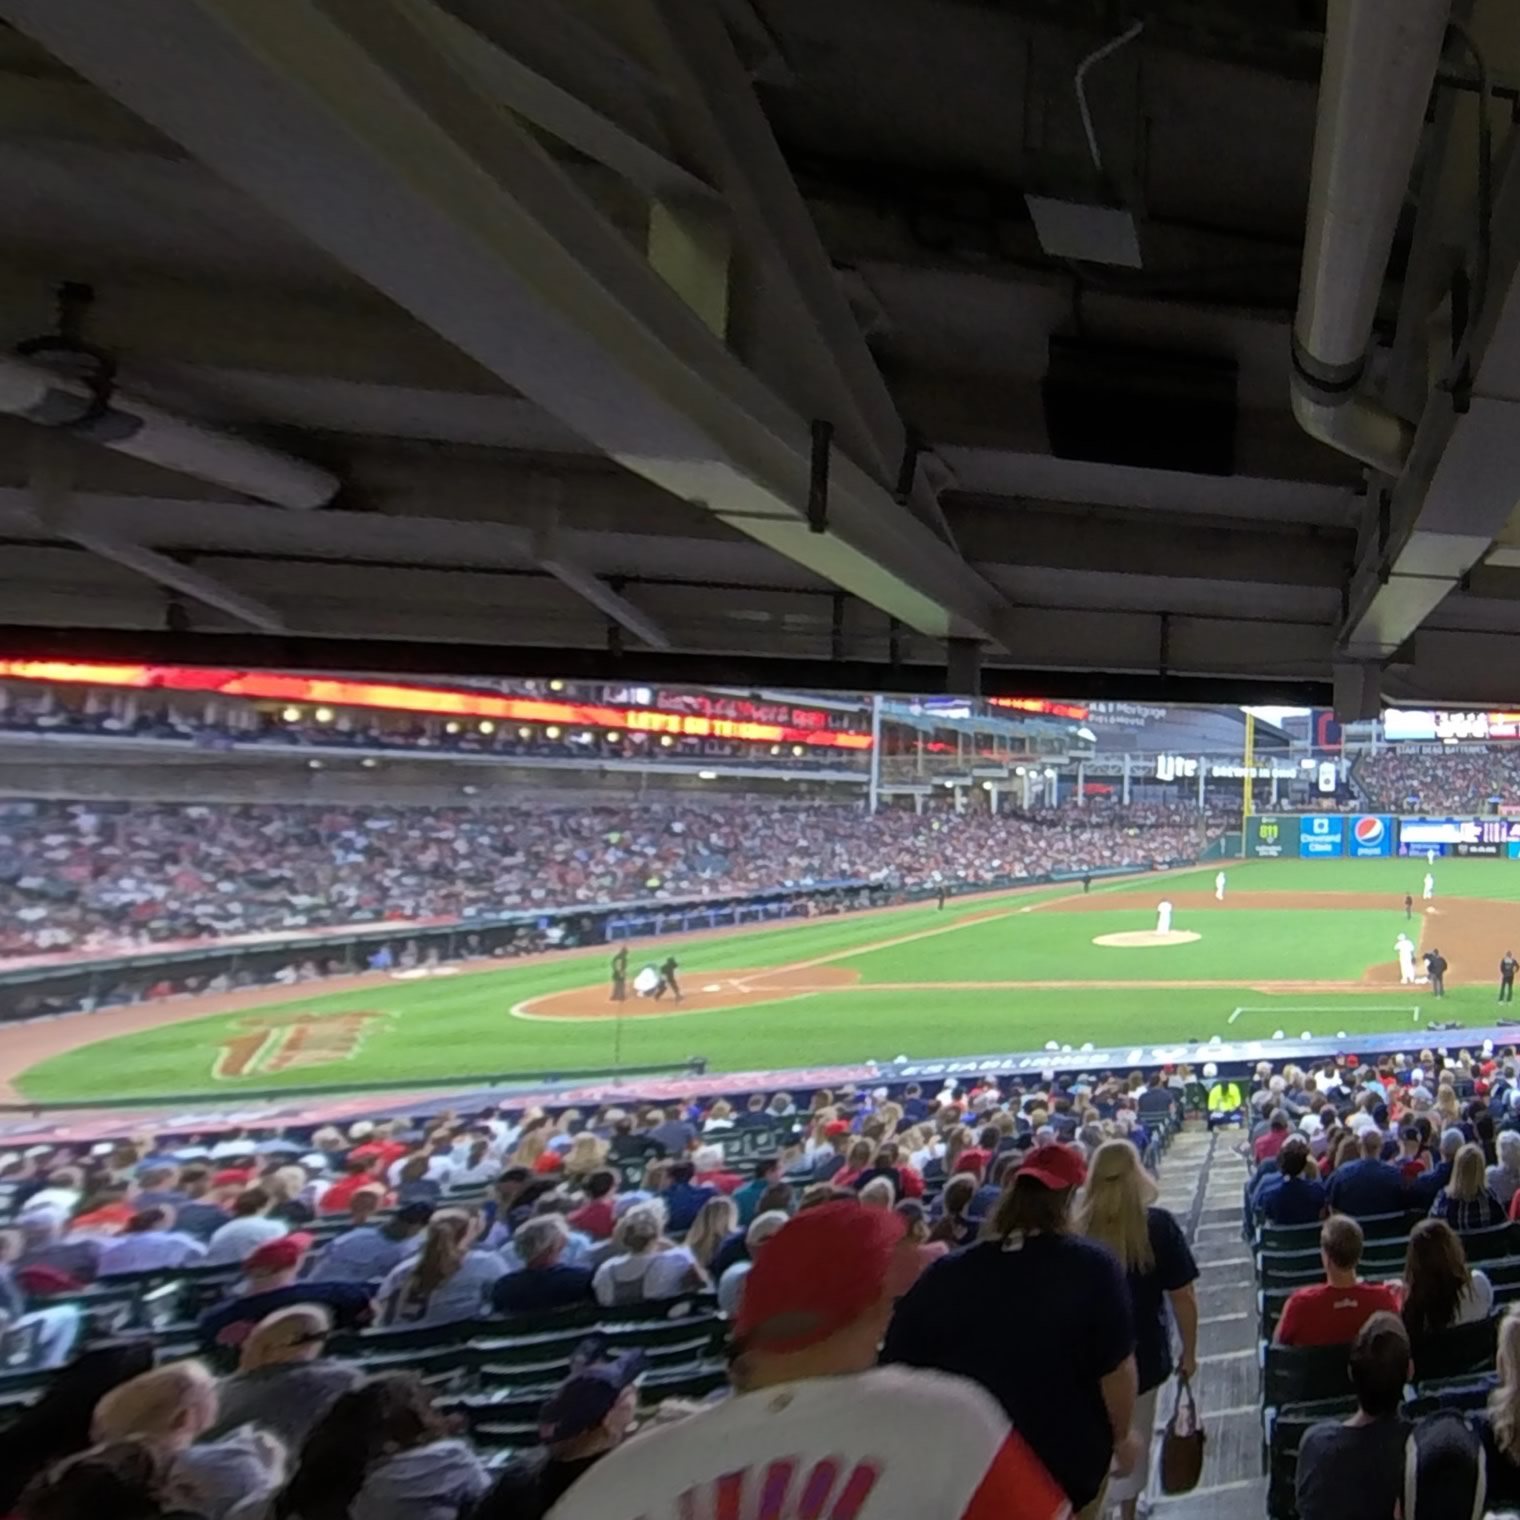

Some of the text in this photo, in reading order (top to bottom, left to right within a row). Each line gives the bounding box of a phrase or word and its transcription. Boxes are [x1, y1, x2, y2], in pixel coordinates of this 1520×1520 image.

[1156, 755, 1198, 782] Lite
[1300, 833, 1341, 843] Cleveland
[1308, 843, 1332, 852] Clinic
[900, 1052, 1109, 1077] ESTABLISHED
